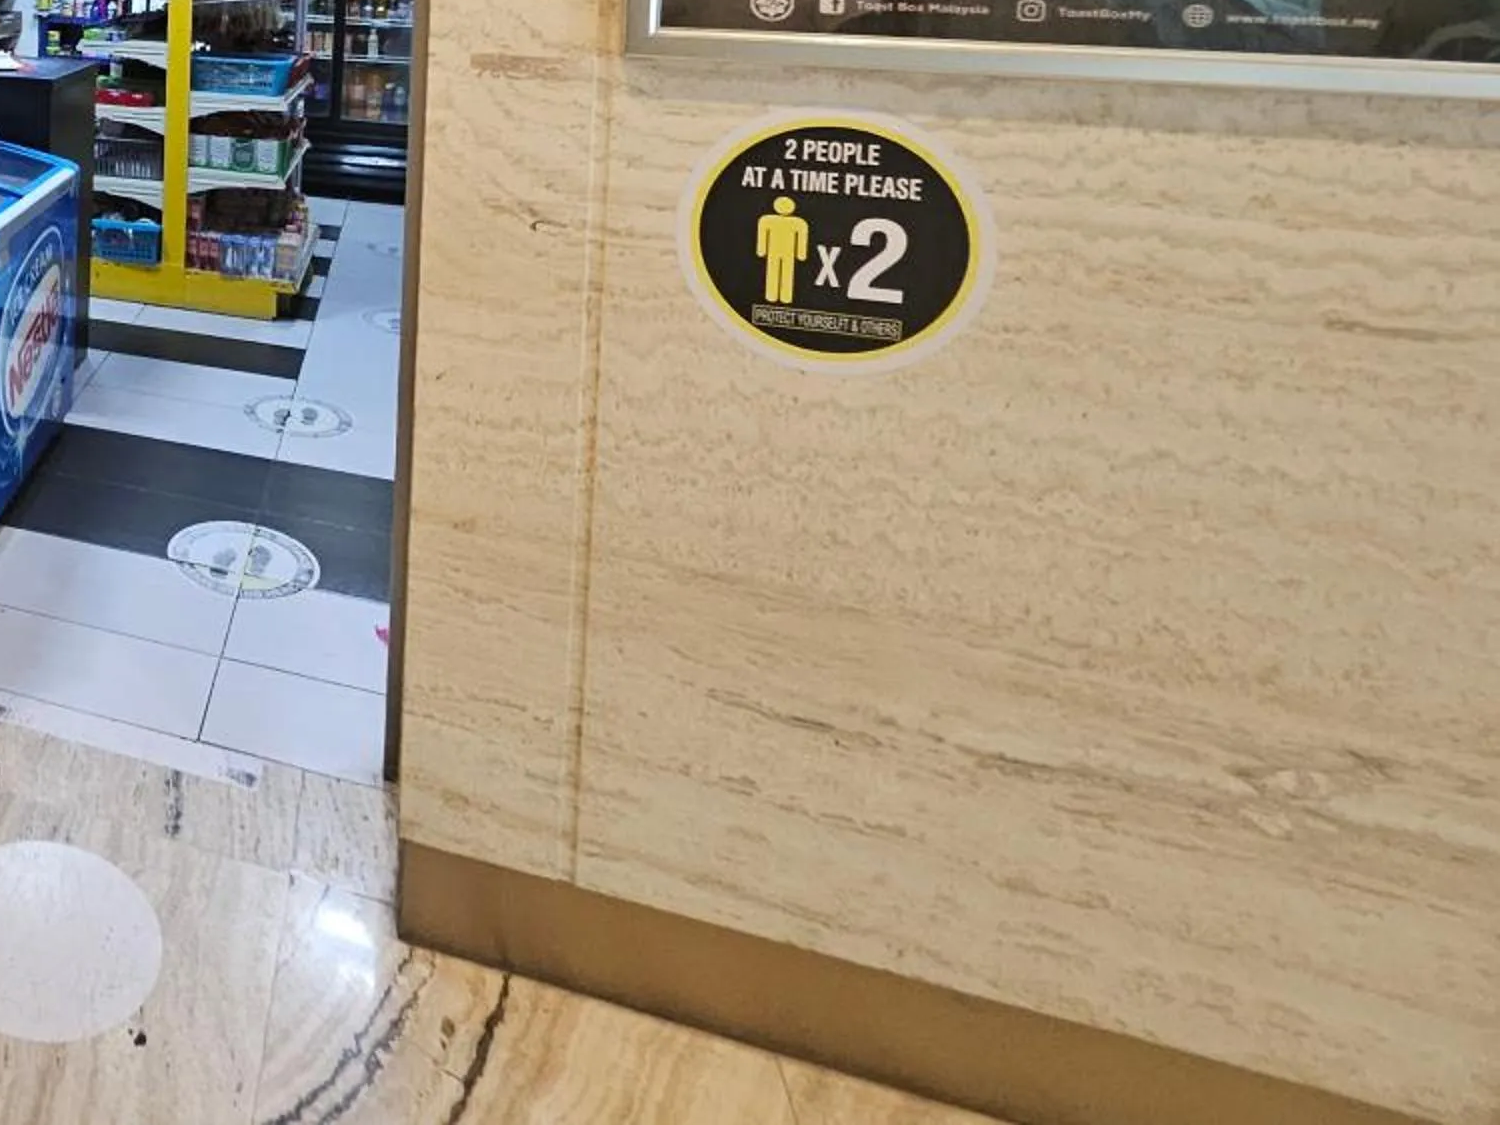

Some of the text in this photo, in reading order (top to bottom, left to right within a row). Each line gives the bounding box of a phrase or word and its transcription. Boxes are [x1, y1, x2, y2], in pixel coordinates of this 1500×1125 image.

[855, 0, 893, 14] Toast
[928, 2, 991, 17] Malaysia
[784, 138, 881, 166] 2 PEOPLE
[741, 166, 924, 201] AT A TIME PLEASE
[755, 308, 796, 326] PROTECT
[861, 320, 899, 338] OTHERS
